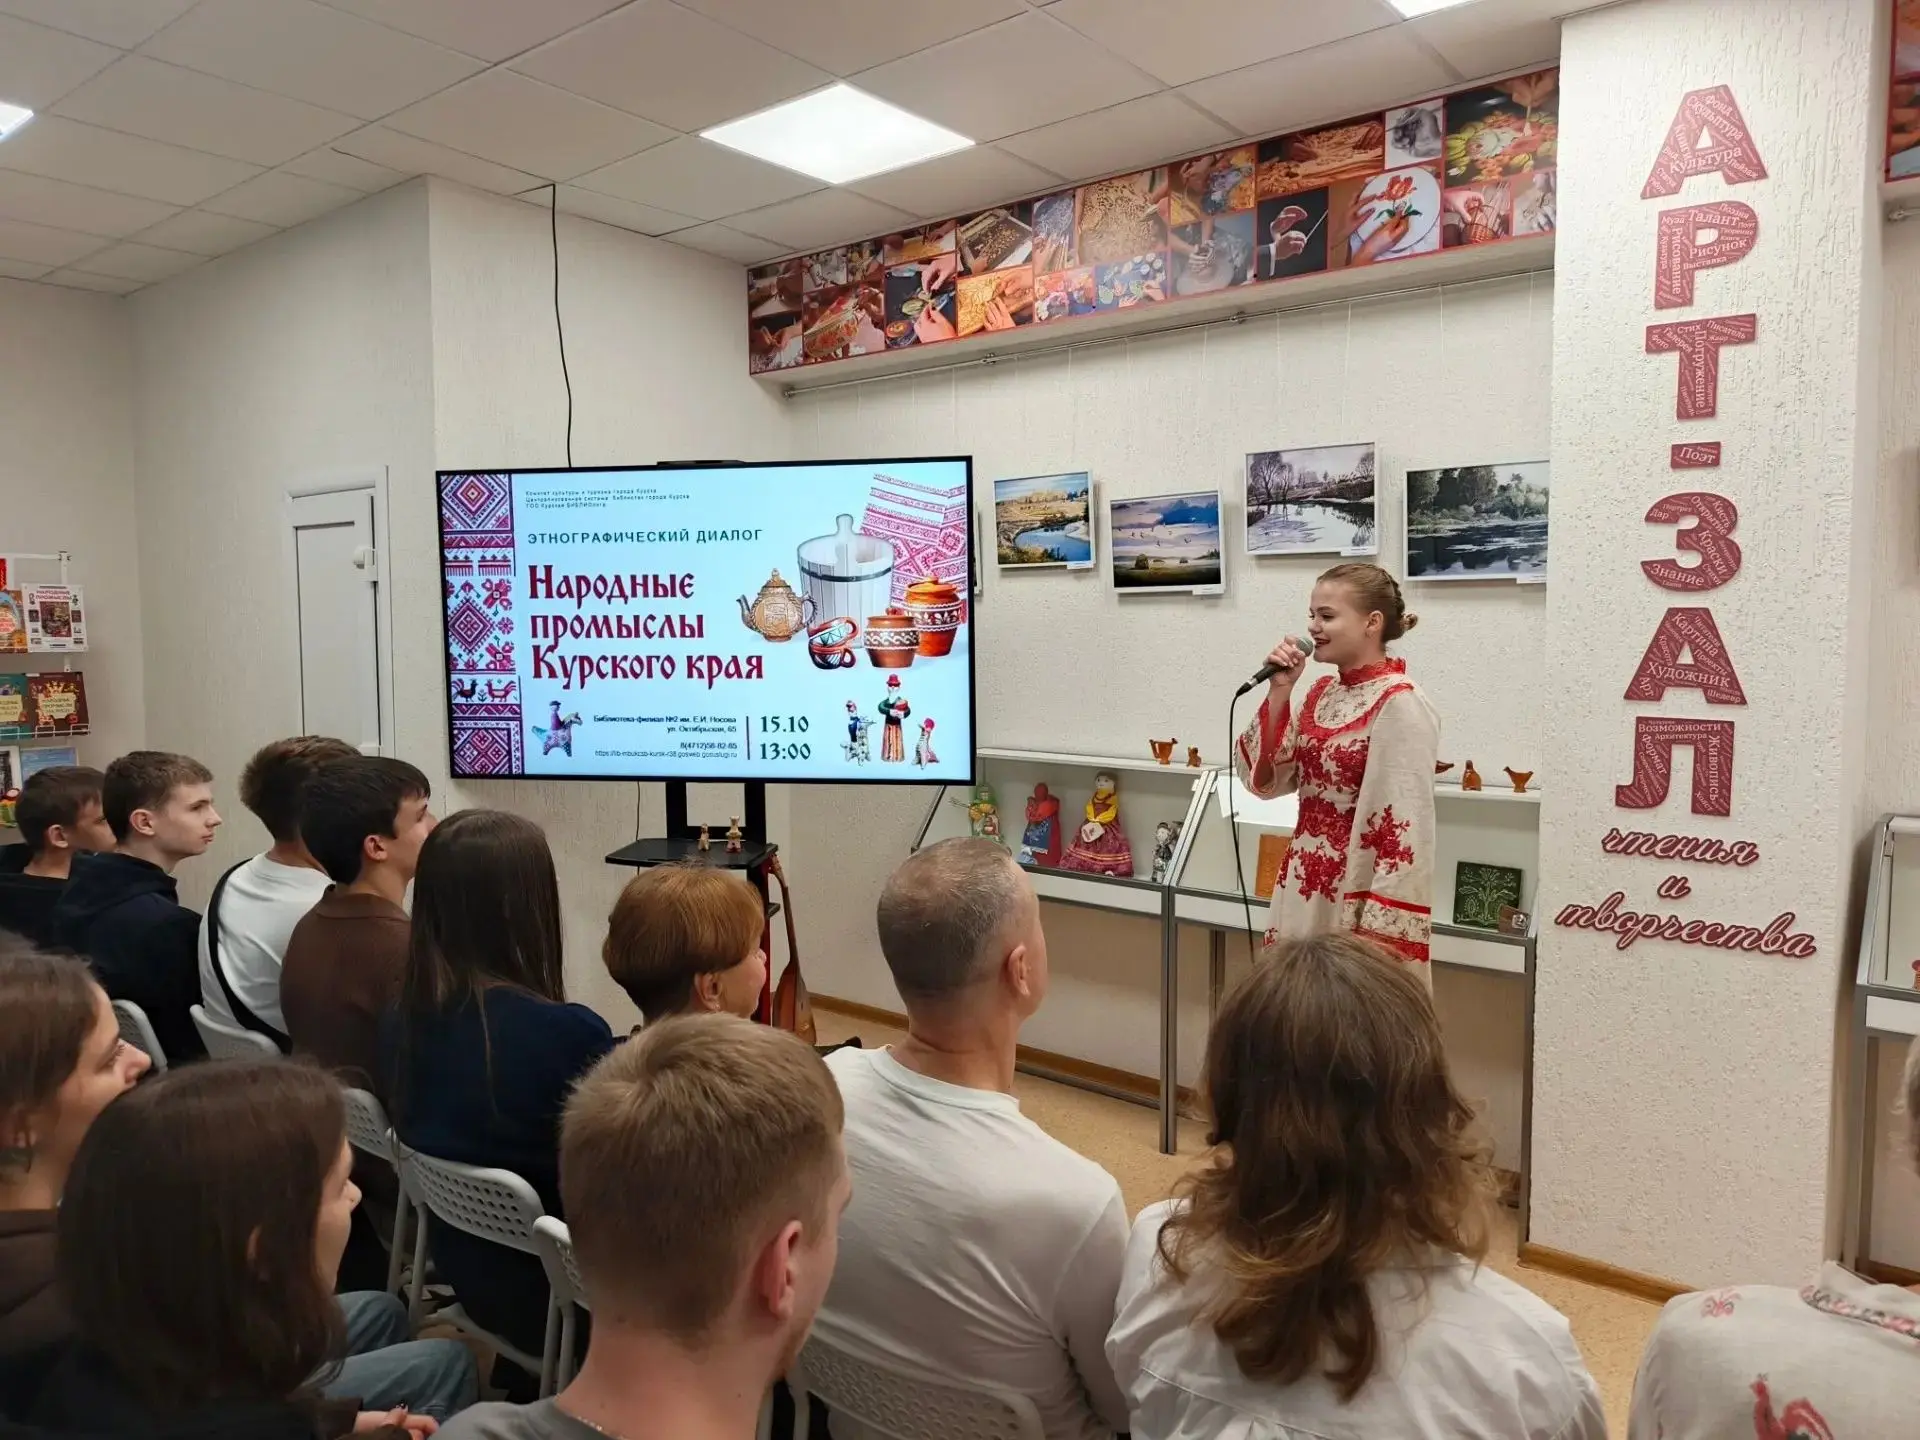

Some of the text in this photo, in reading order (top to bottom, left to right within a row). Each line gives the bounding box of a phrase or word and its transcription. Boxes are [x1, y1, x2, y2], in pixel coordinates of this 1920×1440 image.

[1687, 95, 1744, 141] Скульптура
[1670, 147, 1742, 173] Культура
[1662, 215, 1685, 224] Муза
[1688, 209, 1739, 226] Талант
[1671, 227, 1683, 294] Рисование
[1689, 239, 1747, 258] Рисунок
[1683, 256, 1727, 270] Выставка
[1652, 334, 1669, 349] Фото
[1677, 324, 1701, 334] Стих
[1707, 320, 1746, 339] Писатель
[1692, 330, 1707, 408] Погружение
[1680, 447, 1716, 463] Поэт
[1650, 508, 1669, 520] Дар
[1691, 496, 1728, 535] Открытие
[1713, 500, 1731, 528] Кисть
[527, 528, 763, 545] ЭТНОГРАФИЧЕСКИЙ ДИАЛОГ
[1698, 530, 1728, 574] Краски
[528, 564, 695, 609] Народные
[1651, 563, 1704, 586] Знание
[530, 613, 704, 649] промыслы
[1672, 613, 1719, 657] Картина
[531, 644, 764, 690] Курского края
[1647, 662, 1730, 687] Художник
[1694, 649, 1728, 676] Проекты
[1640, 676, 1654, 697] Арт
[593, 715, 665, 725] Библиотека-филиал
[710, 716, 737, 724] Носова
[760, 715, 810, 733] 15.10
[1638, 723, 1720, 733] Возможности
[1655, 732, 1707, 741] Архитектура
[760, 743, 811, 760] 13:00
[1642, 734, 1667, 774] Формат
[1708, 735, 1720, 801] Живопись
[1601, 827, 1760, 867] чтения
[1657, 873, 1692, 900] и
[1554, 891, 1820, 960] творчества
